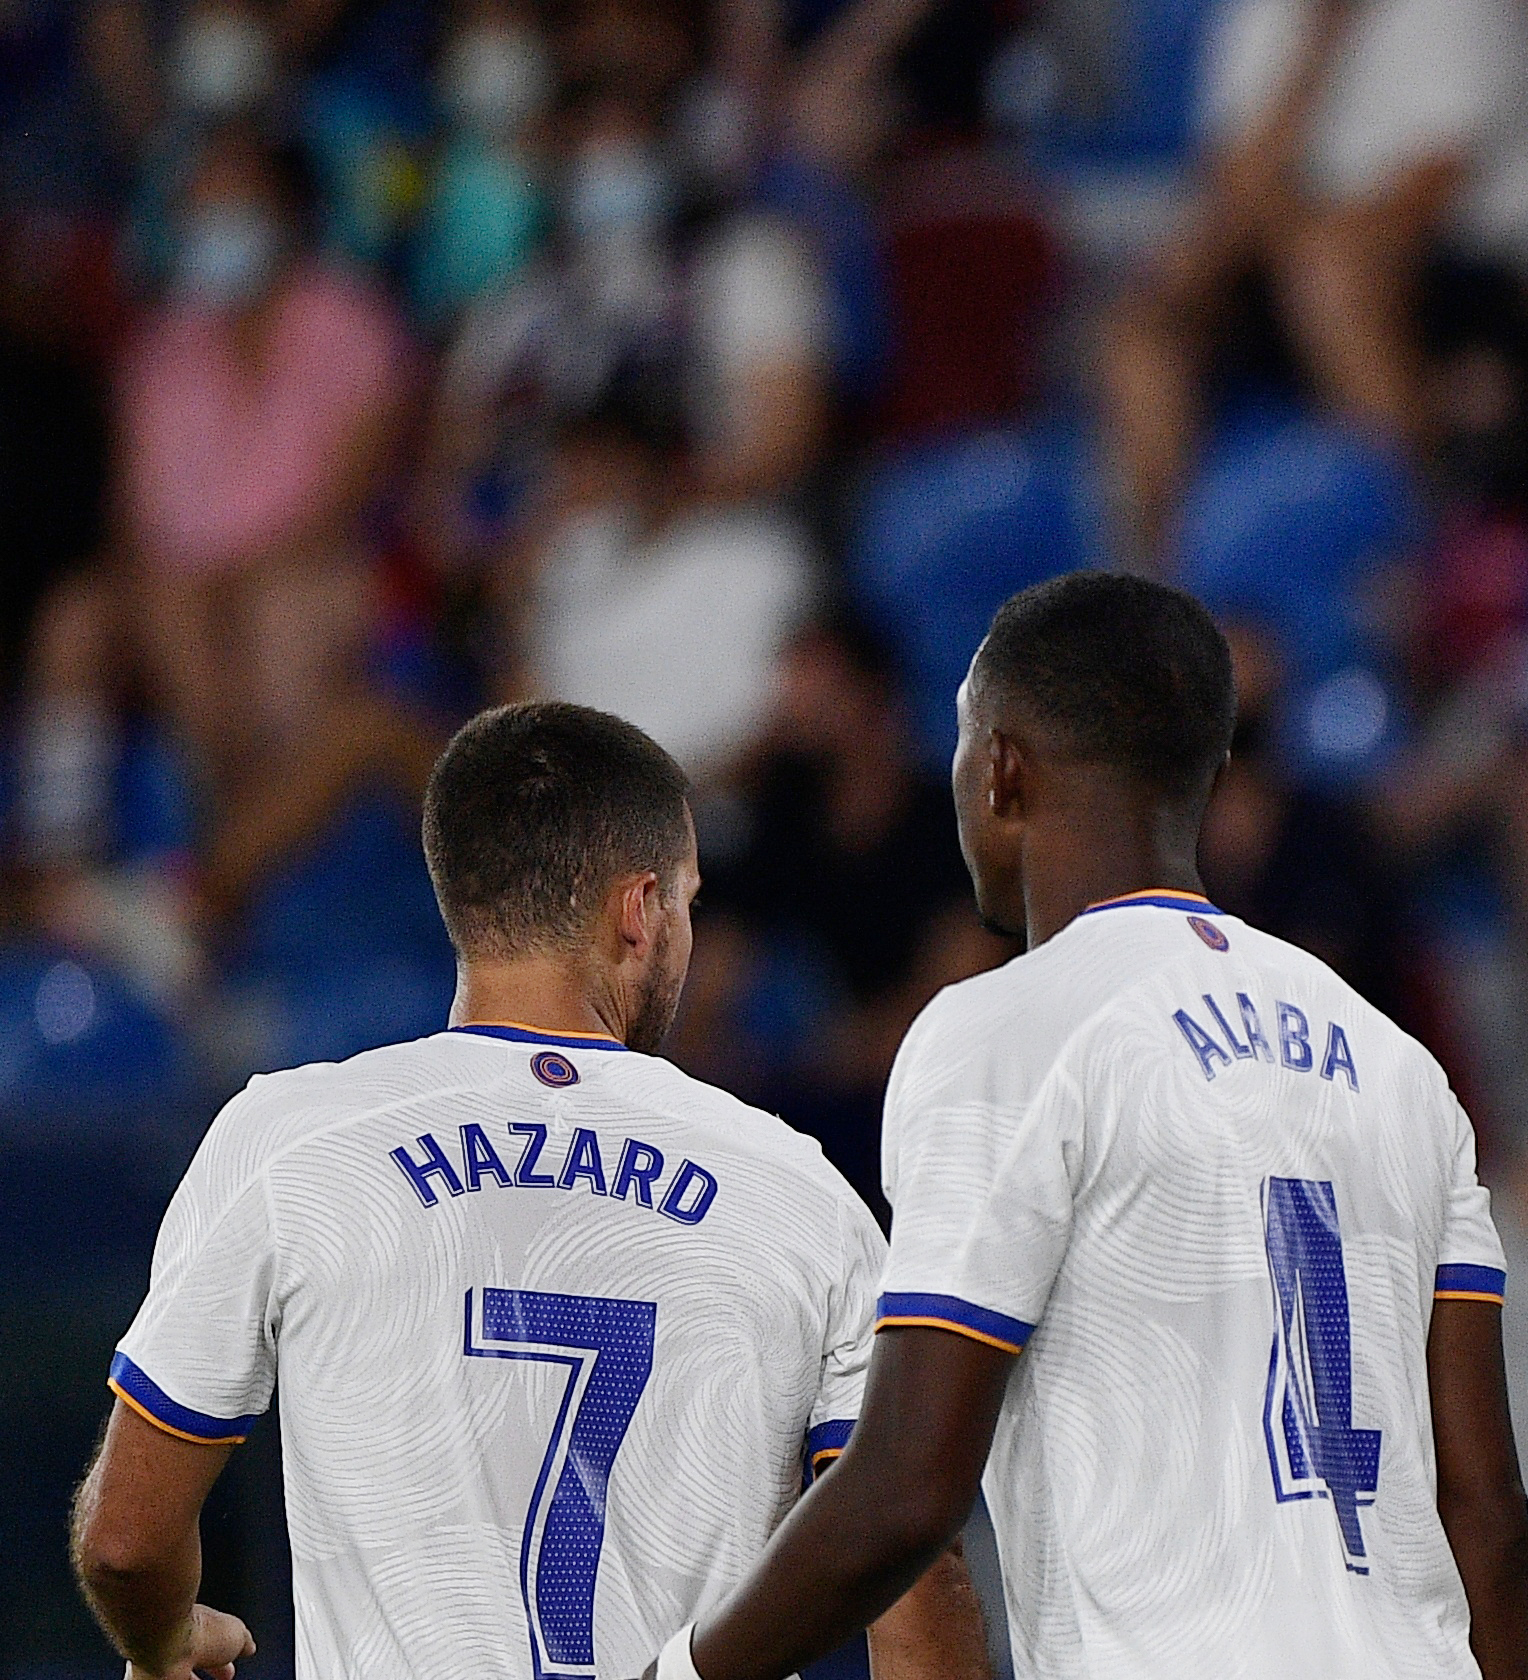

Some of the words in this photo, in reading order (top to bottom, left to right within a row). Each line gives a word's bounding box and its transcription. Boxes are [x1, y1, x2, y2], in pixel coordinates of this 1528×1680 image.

[1172, 992, 1360, 1093] ALABA
[390, 1122, 720, 1227] HAZARD
[1260, 1175, 1383, 1576] 4
